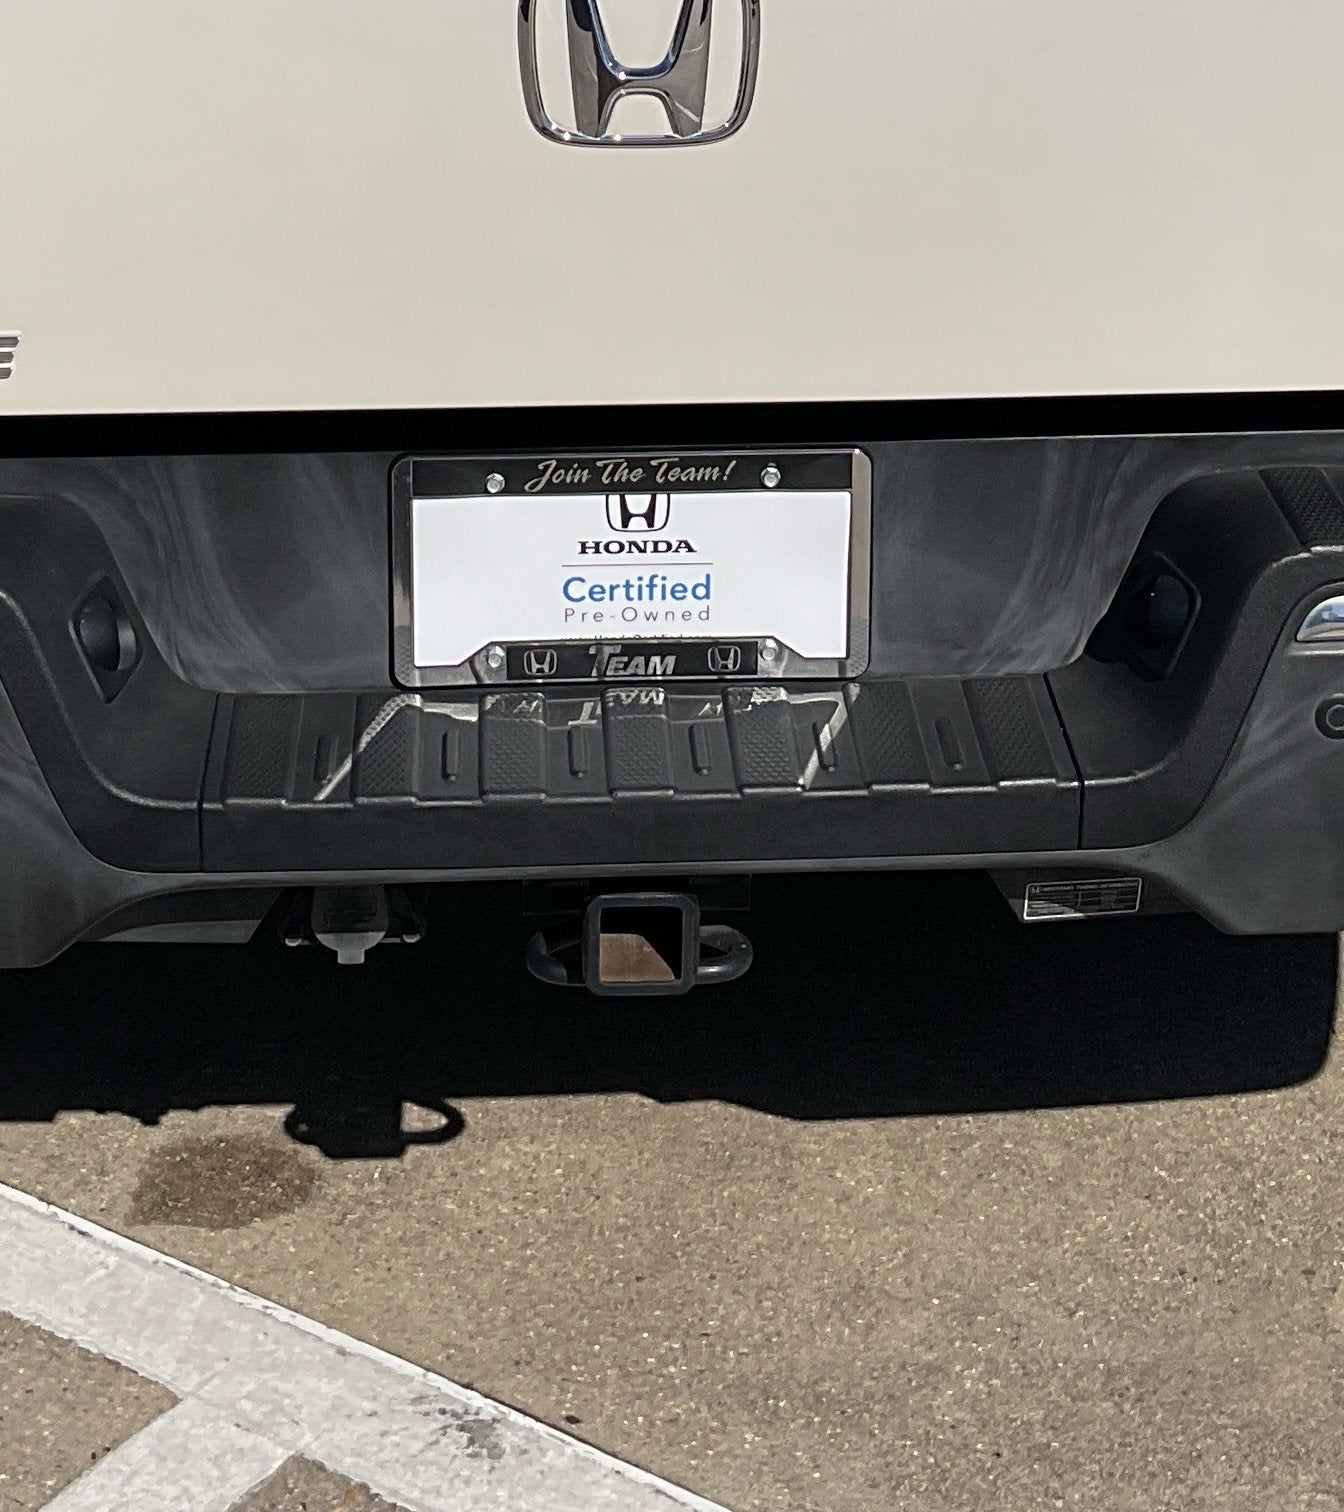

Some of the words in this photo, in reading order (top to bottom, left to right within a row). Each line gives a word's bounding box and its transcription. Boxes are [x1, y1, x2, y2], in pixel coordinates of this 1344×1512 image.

[523, 459, 592, 493] Join
[596, 458, 646, 484] The
[650, 457, 738, 484] Team!
[578, 540, 697, 555] HONDA
[563, 573, 712, 603] Certified
[564, 606, 710, 624] Pre-Owned
[588, 644, 677, 677] TEAM
